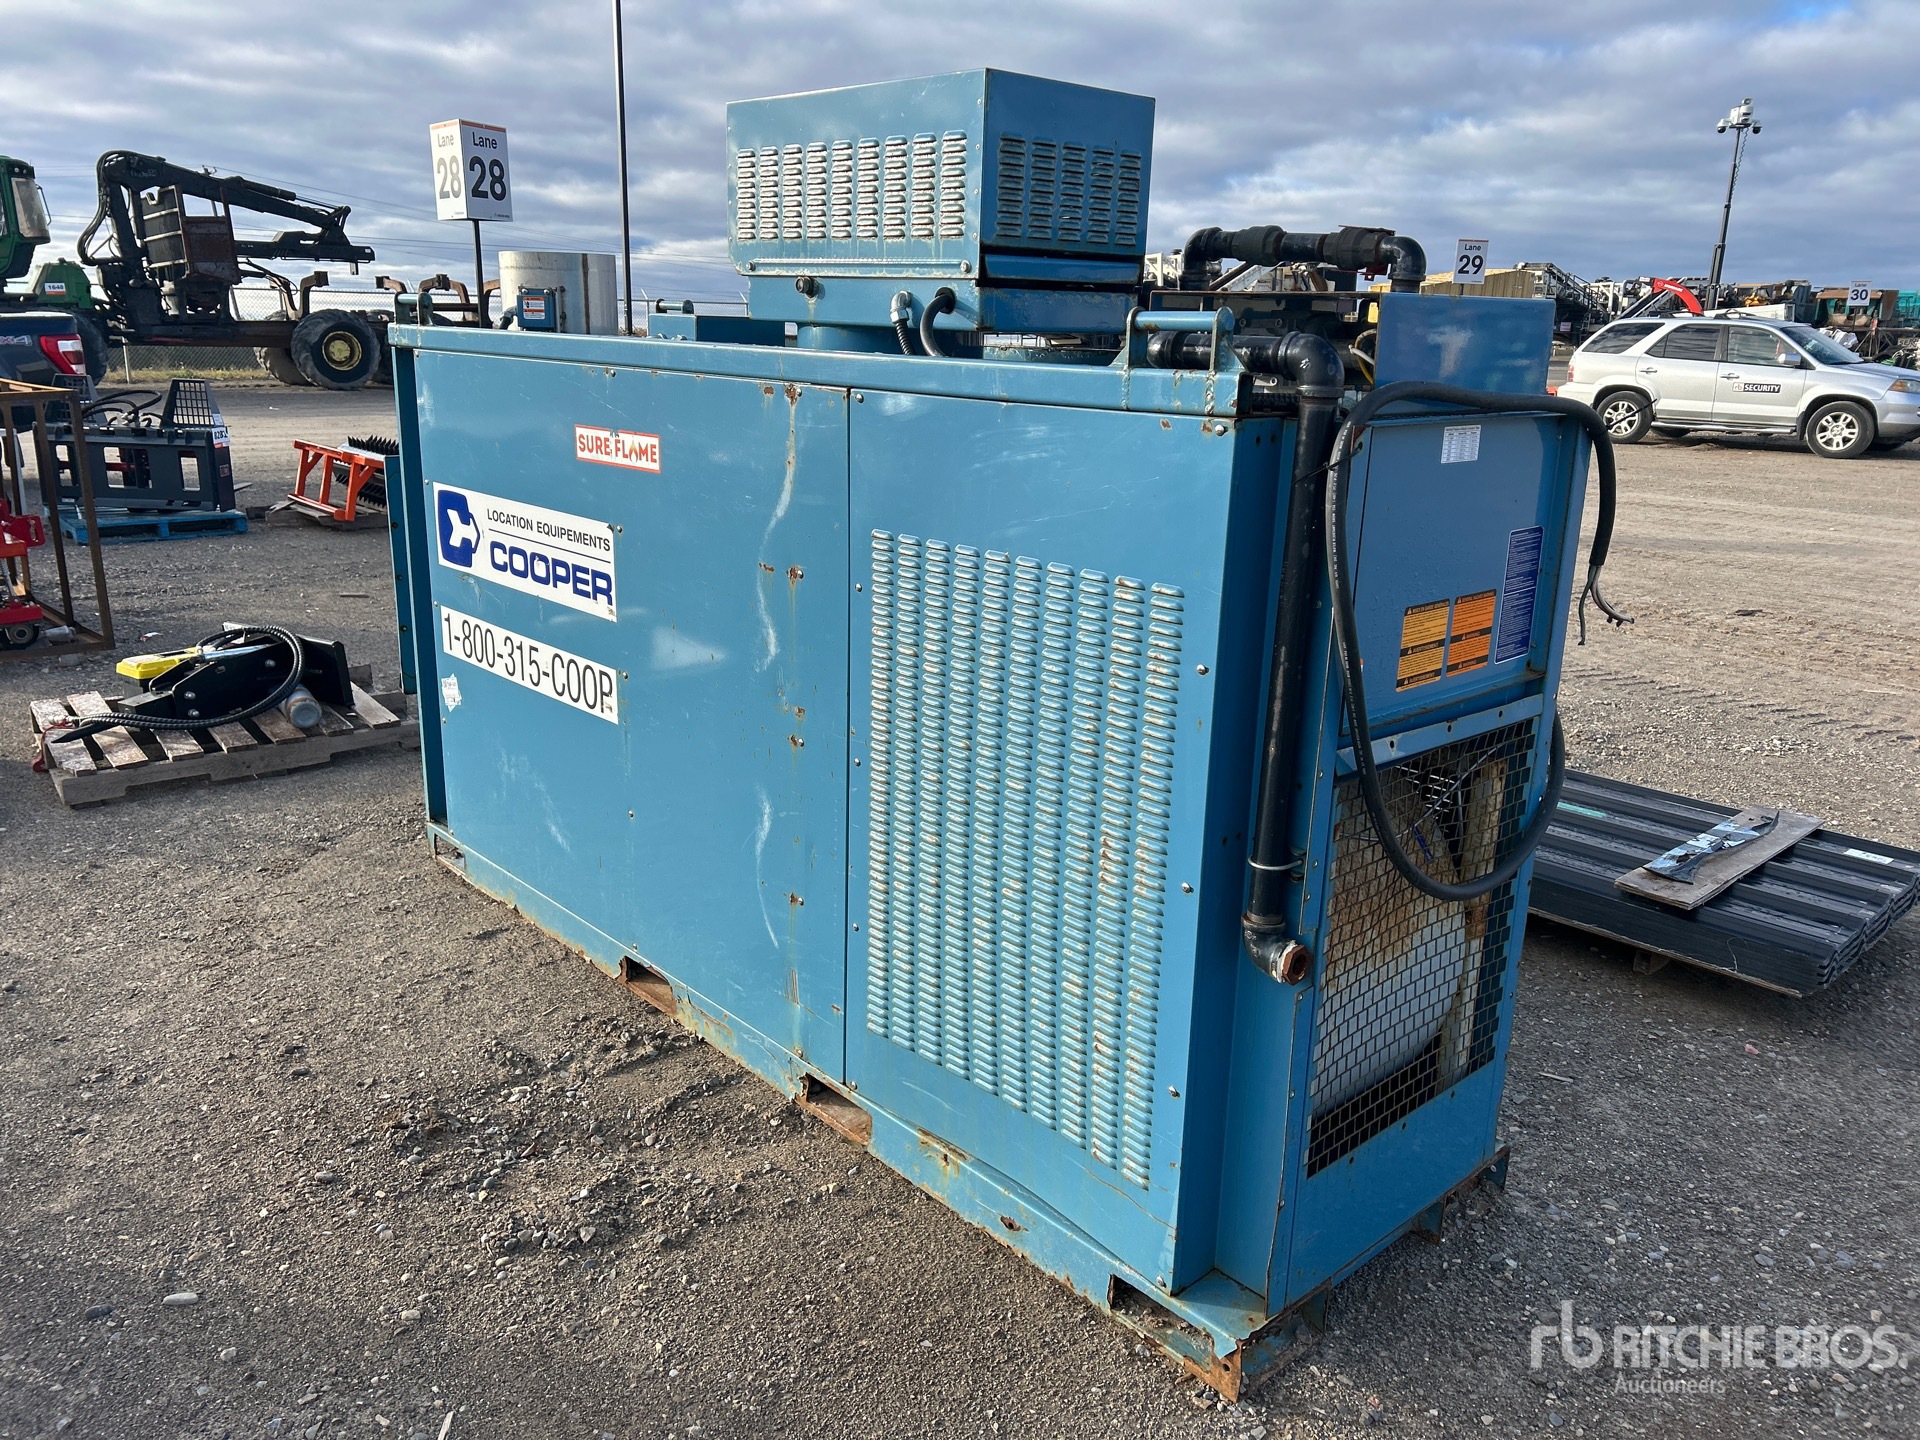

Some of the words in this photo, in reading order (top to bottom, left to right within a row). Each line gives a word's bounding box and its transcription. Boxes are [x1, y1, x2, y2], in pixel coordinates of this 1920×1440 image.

[437, 133, 455, 148] Lane
[472, 131, 498, 149] Lane
[436, 155, 462, 200] 28
[469, 155, 507, 201] 28
[1464, 243, 1482, 251] Lane
[1457, 254, 1484, 275] 29
[1850, 289, 1869, 300] 30
[1744, 384, 1780, 392] SECURITY
[578, 433, 611, 456] SURE
[486, 508, 534, 531] LOCATION
[536, 520, 611, 552] EQUIPEMENTS
[489, 540, 613, 606] COOPER
[443, 612, 613, 714] 1-800-315-COOP
